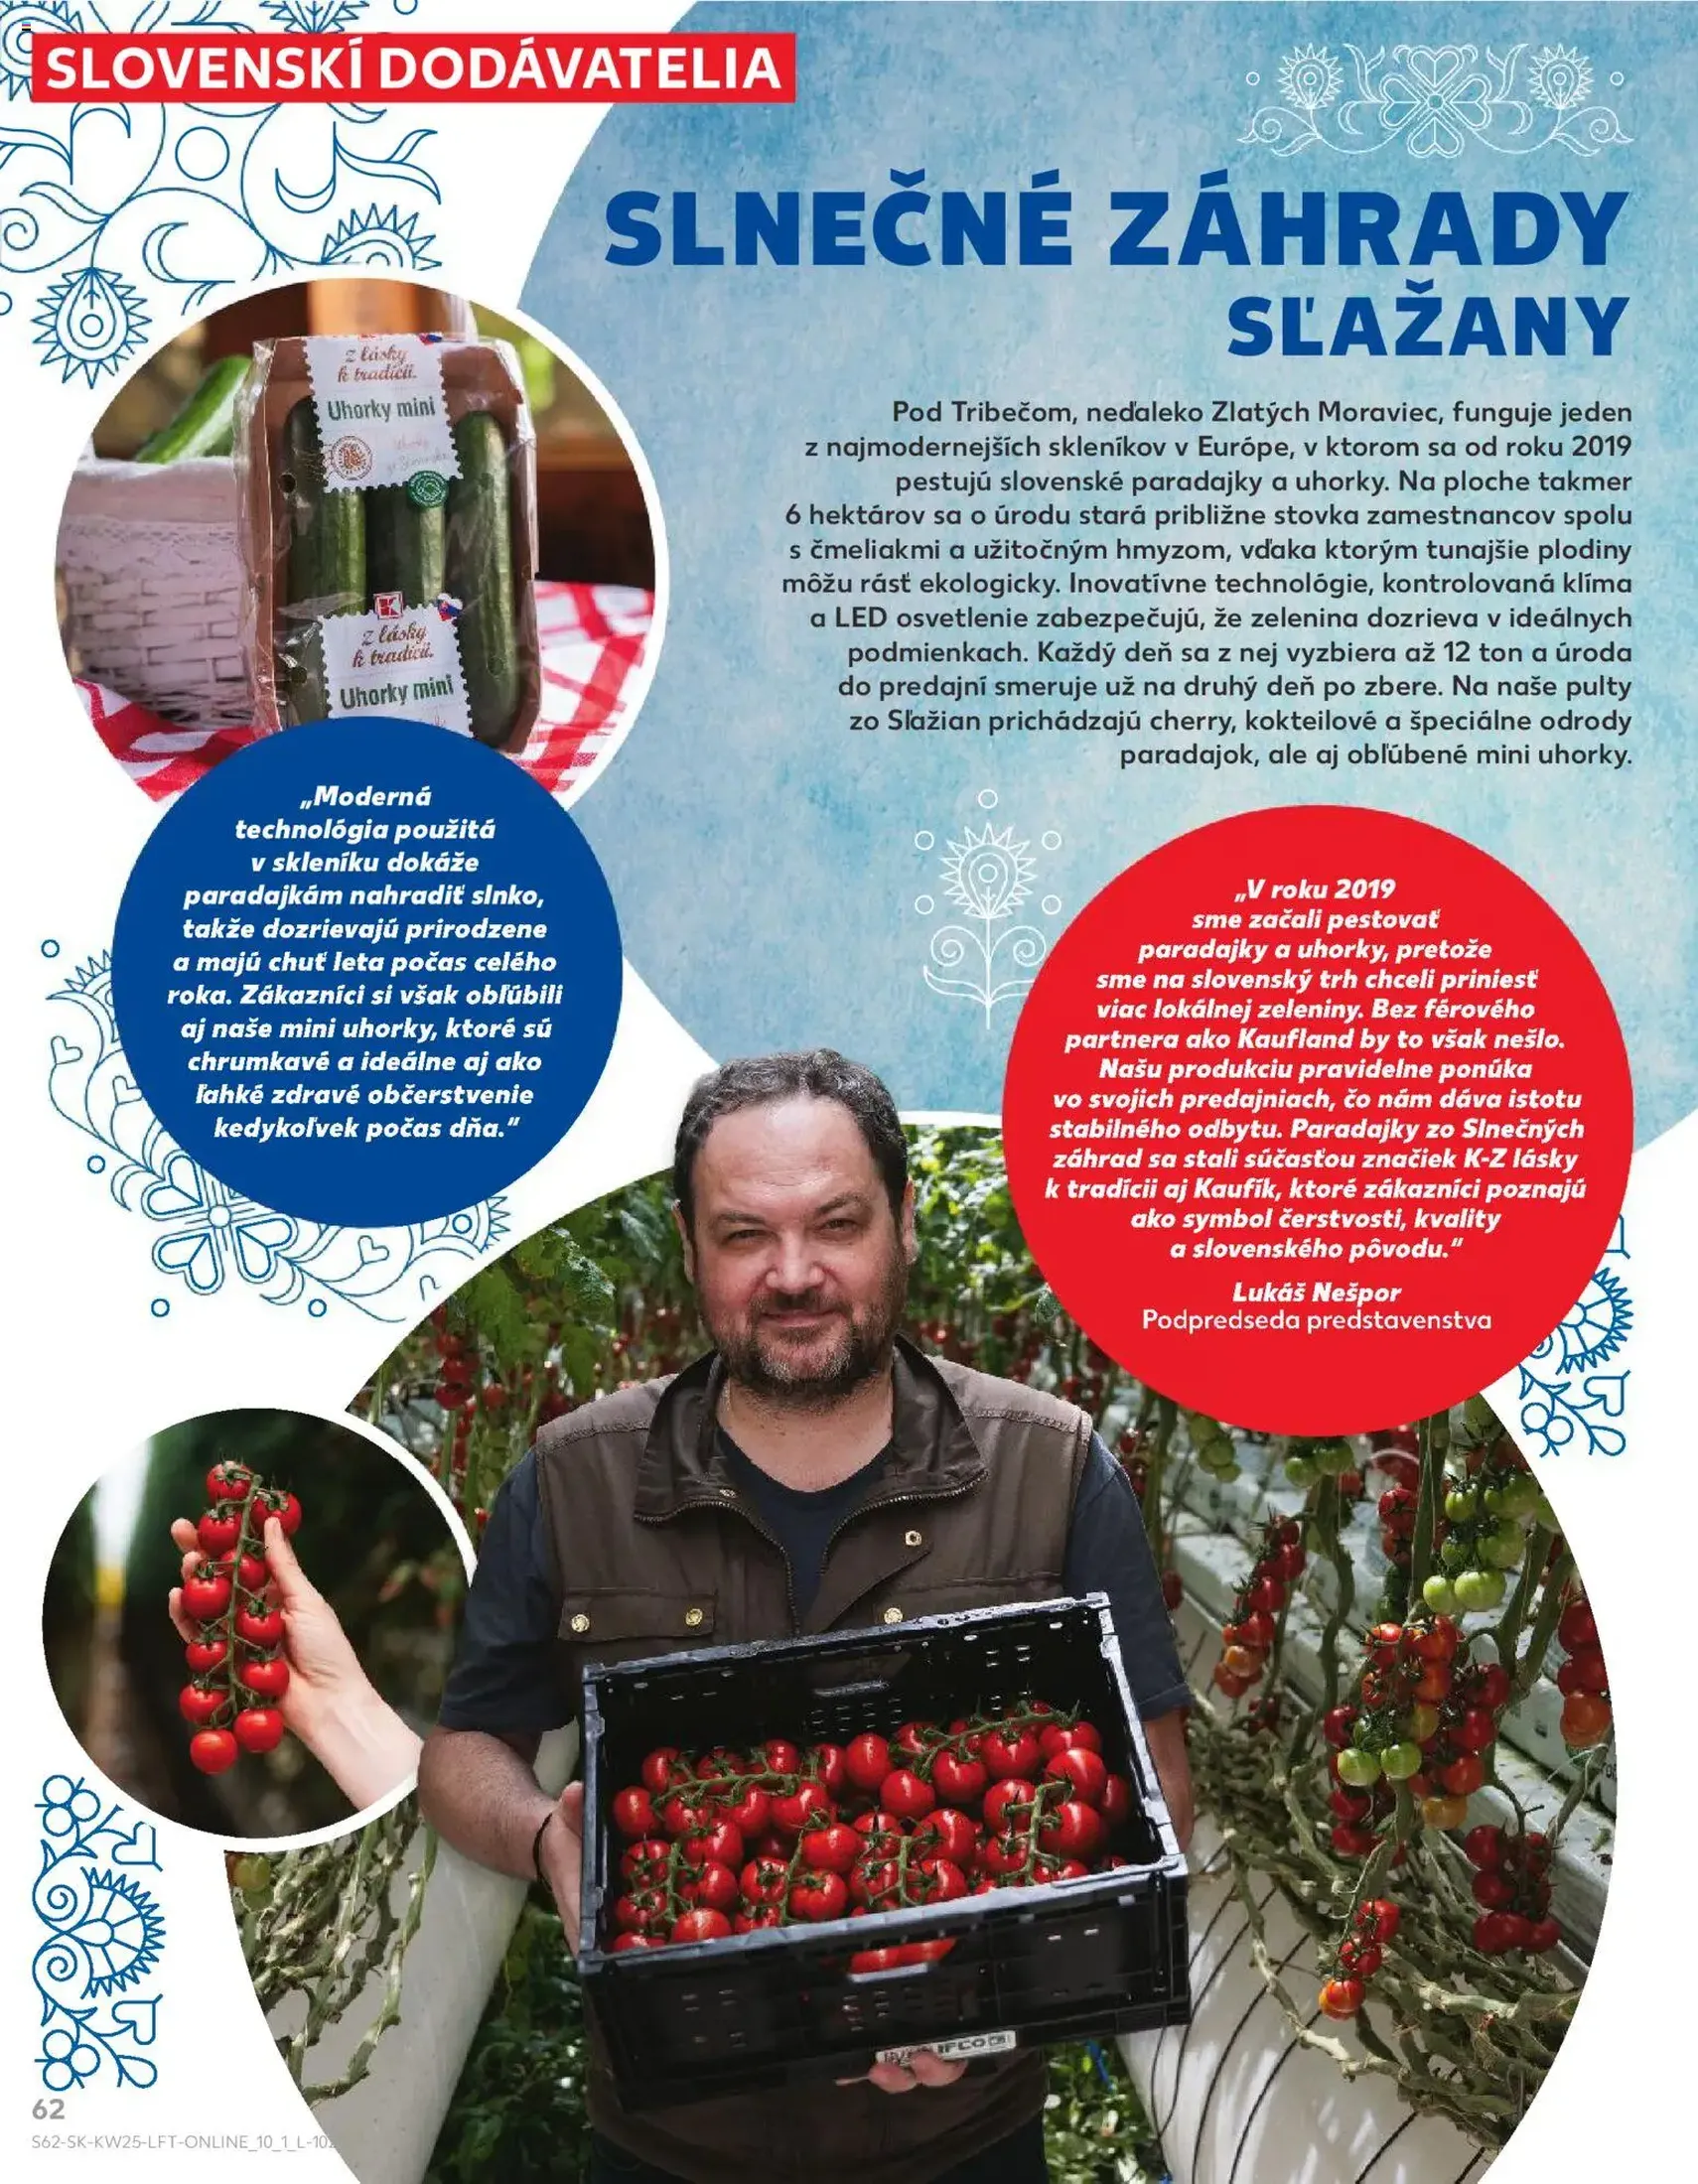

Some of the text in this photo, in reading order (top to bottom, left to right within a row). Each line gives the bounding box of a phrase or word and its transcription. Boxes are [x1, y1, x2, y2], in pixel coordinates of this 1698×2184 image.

[47, 37, 781, 89] SLOVENSKÍ DODÁVATELIA
[605, 168, 1630, 267] SLNEČNÉ ZÁHRADY
[1227, 278, 1630, 356] SĽAŽANY
[328, 396, 436, 423] Uhorky mini
[893, 400, 1632, 428] Pod Tribečom, neďaleko Zlatých Moraviec, funguje jeden
[804, 435, 1632, 463] z najmodernejších skleníkov v Európe, v ktorom sa od roku 2019
[896, 470, 1632, 497] pestujú slovenské paradajky a uhorky. Na ploche takmer
[782, 571, 1632, 600] môžu rásť ekologicky. Inovatívne technológie, kontrolovaná klíma
[379, 621, 427, 644] lásky
[810, 606, 1632, 633] a LED osvetlenie zabezpečujú, že zelenina dozrieva v ideálnych
[340, 673, 454, 710] Uhorky mini
[849, 709, 1632, 737] zo Sľažian prichádzajú cherry, kokteilové a špeciálne odrody
[1120, 743, 1632, 770] paradajok, ale aj obľúbené mini uhorky.
[235, 818, 496, 845] technológia použitá
[251, 851, 480, 873] v skleníku dokáže
[1271, 879, 1329, 899] roku
[1334, 879, 1396, 899] 2019
[183, 917, 547, 944] takže dozrievajú prirodzene
[1192, 908, 1441, 934] sme začali pestovať
[173, 951, 557, 978] a majú chuť leta počas celého
[1137, 938, 1492, 964] paradajky a uhorky, pretože
[167, 984, 563, 1006] roka. Zákazníci si však obľúbili
[1097, 998, 1535, 1024] viac lokálnej zeleniny. Bez férového
[1063, 1027, 1565, 1053] partnera ako Kaufland by to však nešlo.
[188, 1050, 542, 1077] chrumkavé a ideálne aj ako
[1098, 1057, 1533, 1084] Našu produkciu pravidelne ponúka
[195, 1083, 534, 1105] ľahké zdravé občerstvenie
[213, 1116, 360, 1144] kedykoľvek
[365, 1117, 442, 1143] počas
[1049, 1117, 1585, 1145] stabilného odbytu. Paradajky zo Slnečných
[1045, 1177, 1587, 1203] k tradícii aj Kaufík, ktoré zákazníci poznajú
[1170, 1243, 1187, 1259] a
[1192, 1237, 1344, 1259] slovenského
[1232, 1282, 1403, 1307] Lukáš Nešpor
[1143, 1308, 1491, 1334] Podpredseda predstavenstva
[937, 2038, 986, 2053] IFCO
[30, 2097, 67, 2121] 62
